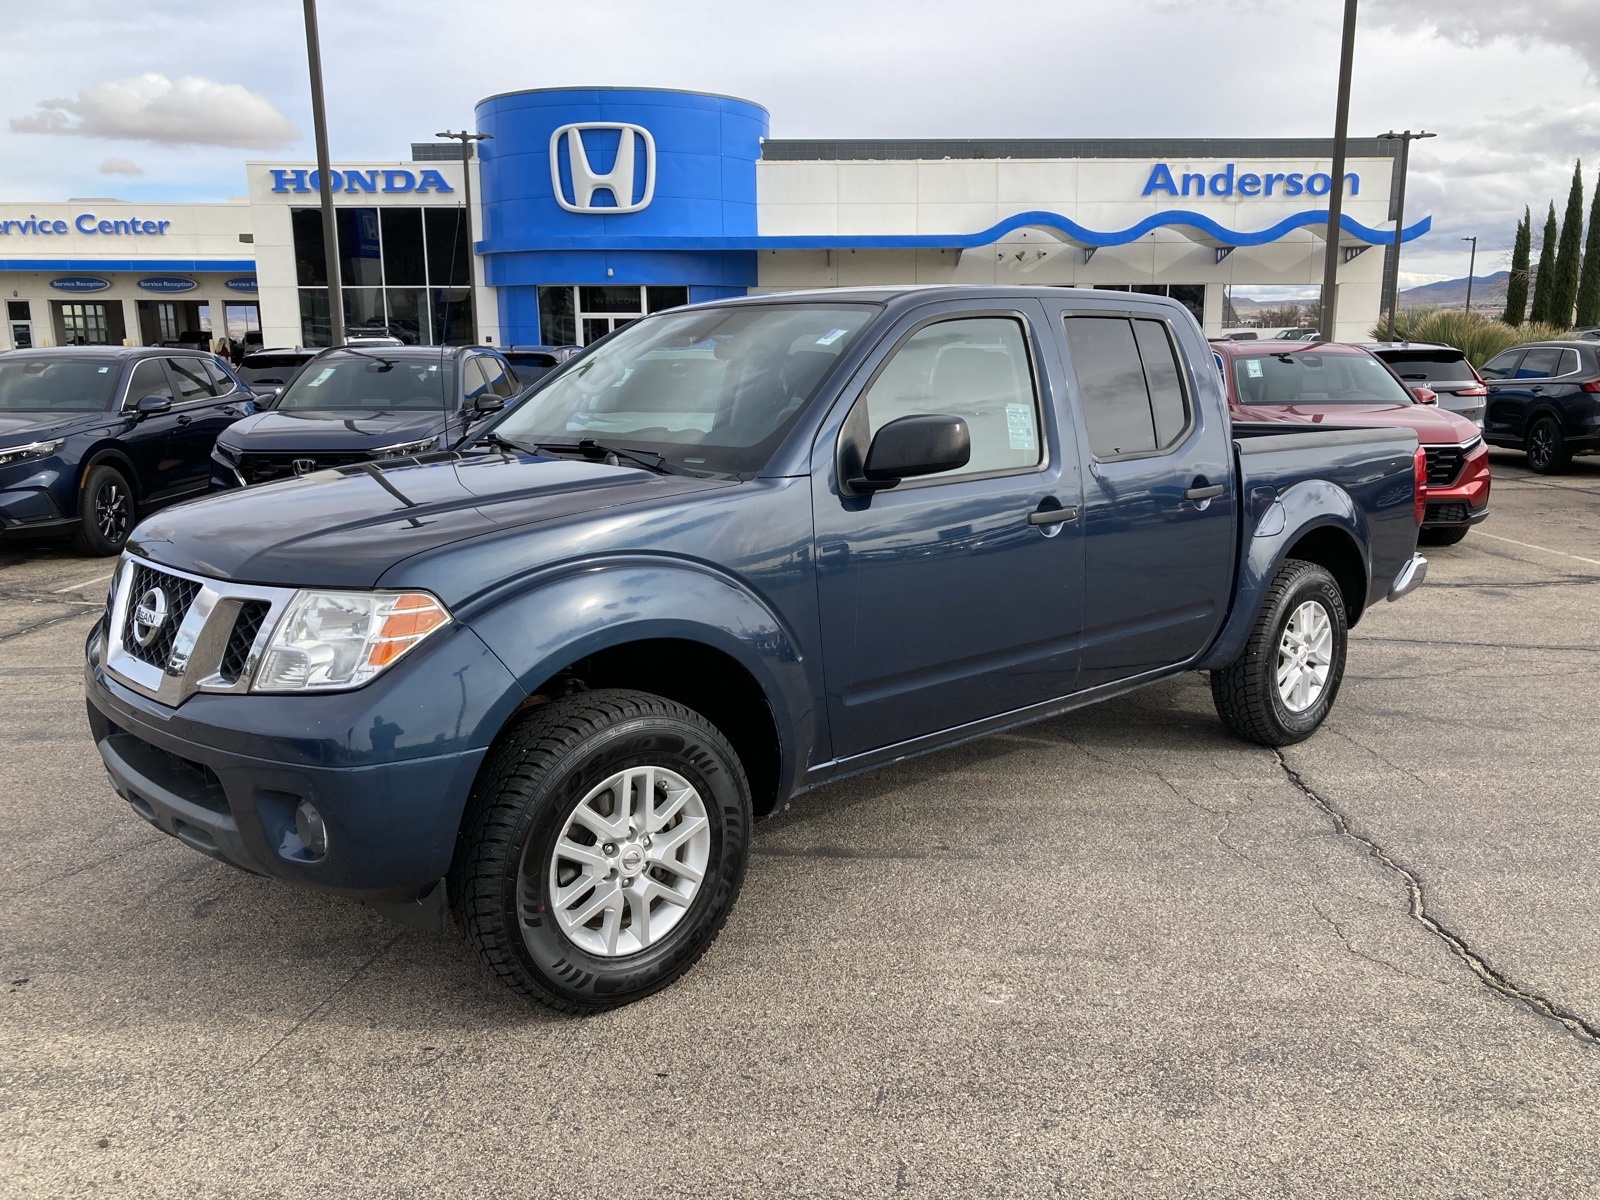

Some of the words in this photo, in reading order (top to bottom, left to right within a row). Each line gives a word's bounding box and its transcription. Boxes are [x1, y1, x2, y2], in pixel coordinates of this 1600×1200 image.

[270, 169, 454, 193] HONDA
[1141, 163, 1360, 196] Anderson
[0, 214, 68, 235] rvice
[75, 213, 170, 235] Center
[76, 280, 106, 288] Reception
[163, 280, 193, 288] Reception
